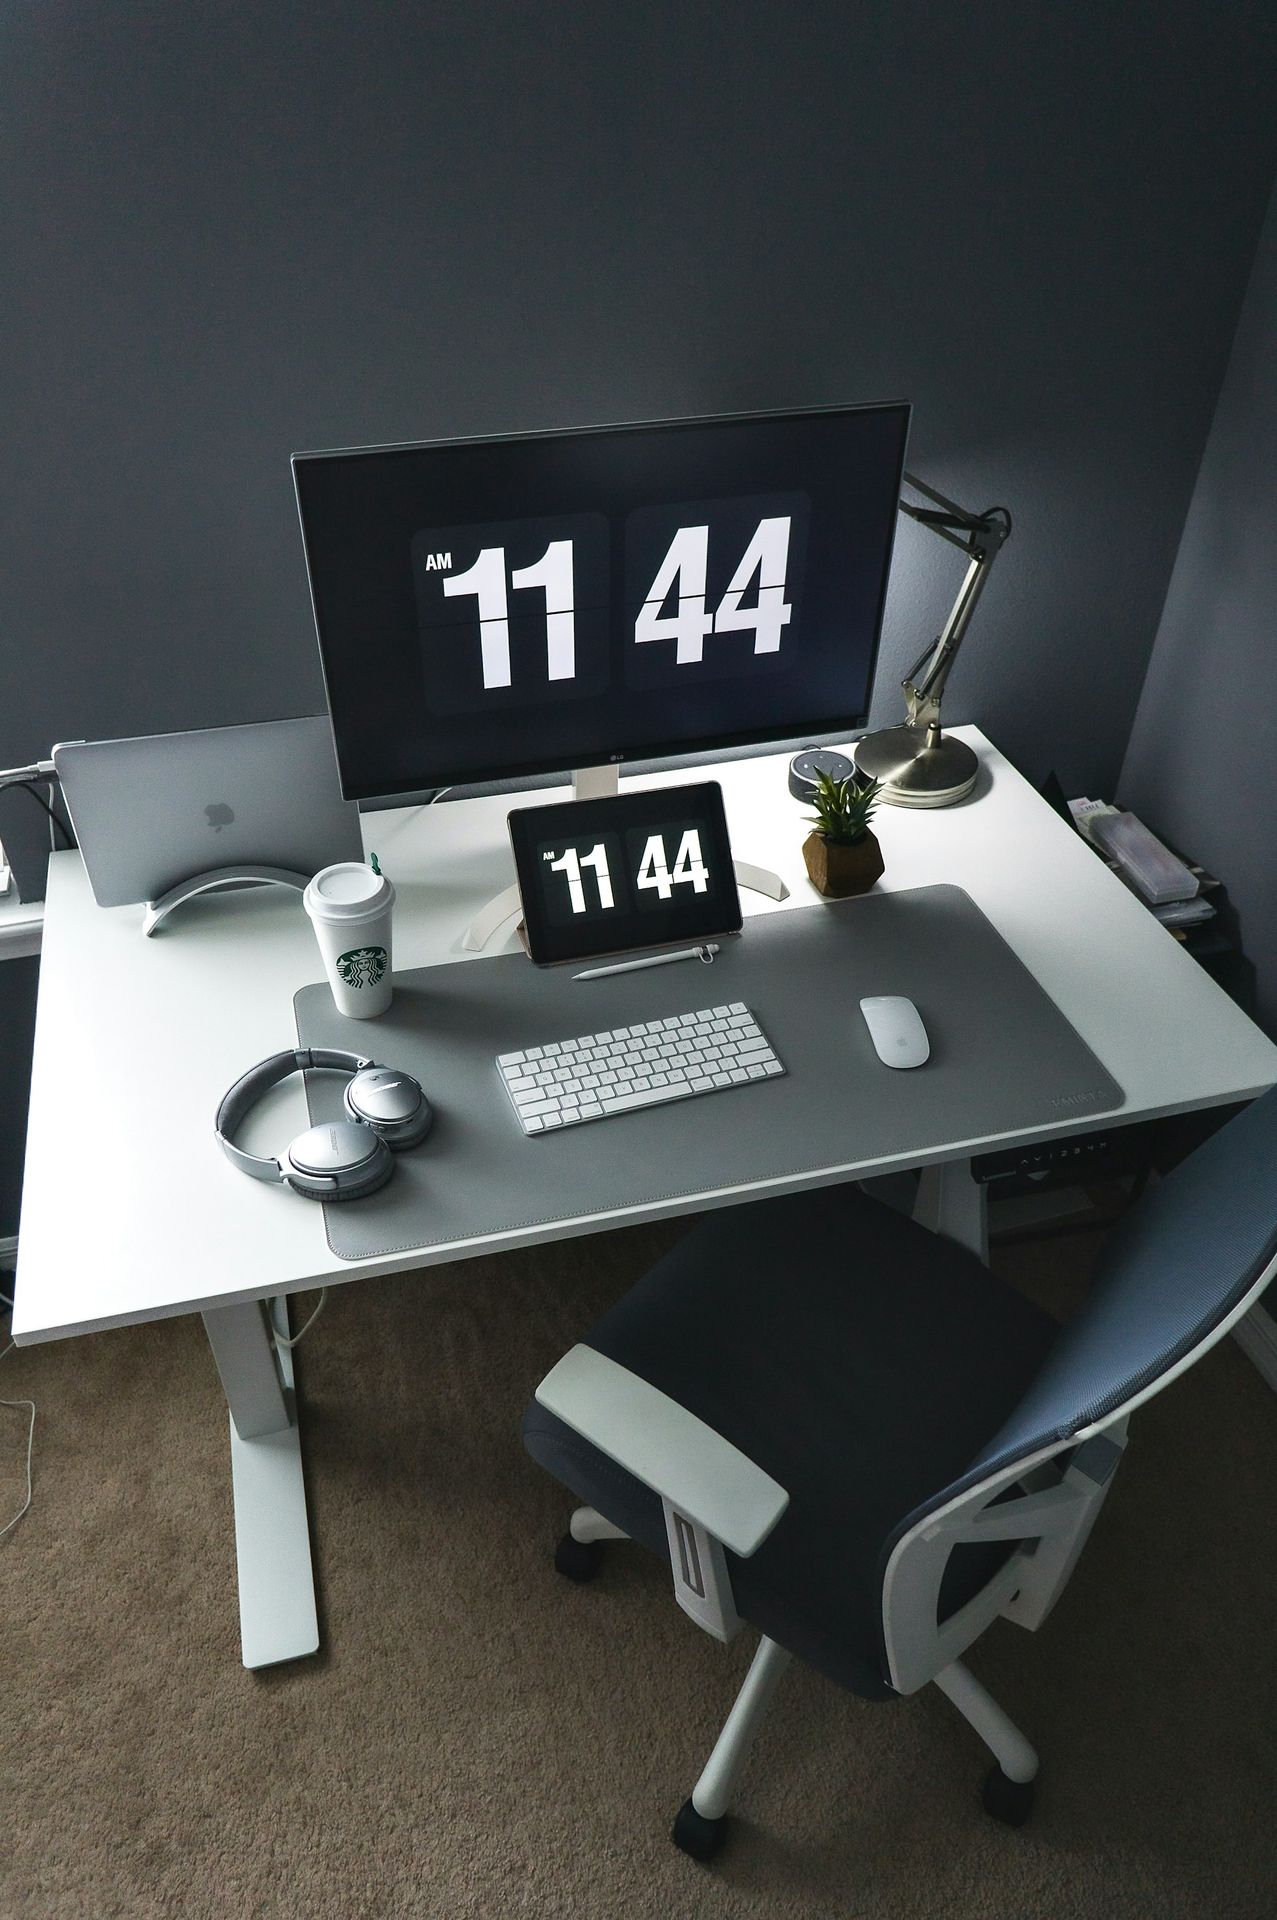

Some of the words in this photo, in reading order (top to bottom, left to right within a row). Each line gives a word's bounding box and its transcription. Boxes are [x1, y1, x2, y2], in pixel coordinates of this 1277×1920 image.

[425, 552, 453, 571] AM
[442, 539, 576, 689] 11
[634, 516, 792, 665] 44
[543, 851, 555, 861] AM
[550, 843, 615, 914] 11
[636, 829, 710, 900] 44
